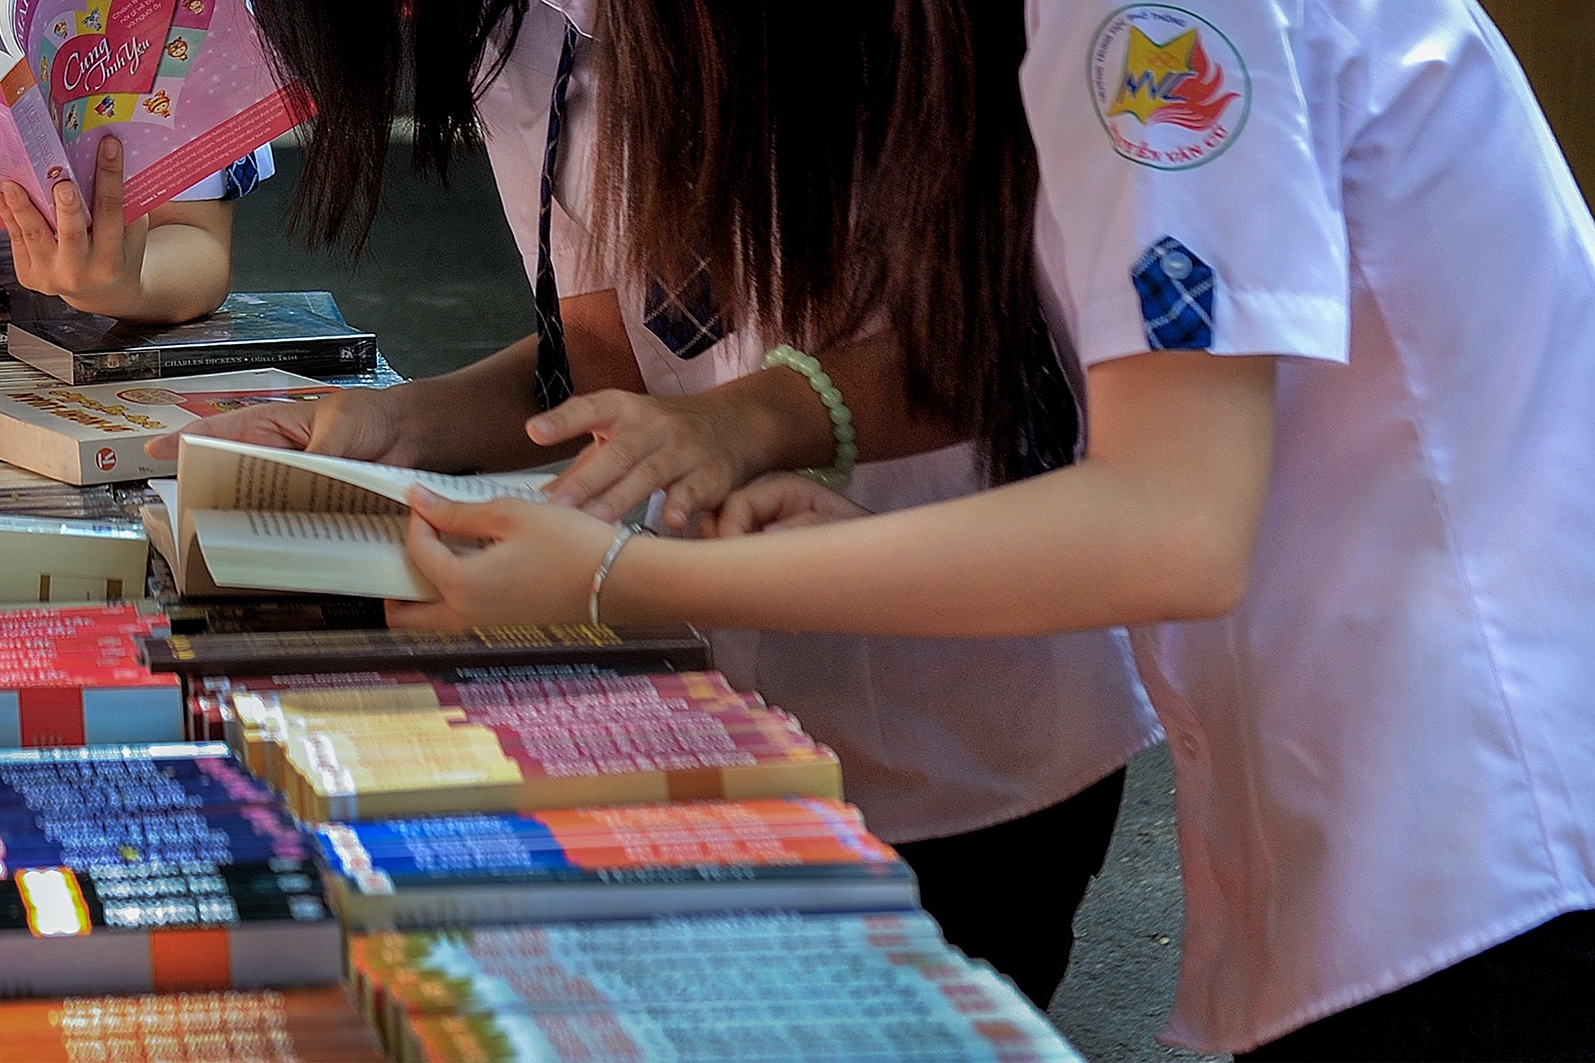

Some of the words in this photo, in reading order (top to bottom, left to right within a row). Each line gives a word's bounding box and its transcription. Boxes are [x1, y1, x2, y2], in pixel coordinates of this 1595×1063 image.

[63, 37, 112, 91] Cung
[164, 359, 204, 368] CHARLES
[205, 356, 243, 365] DICKENS
